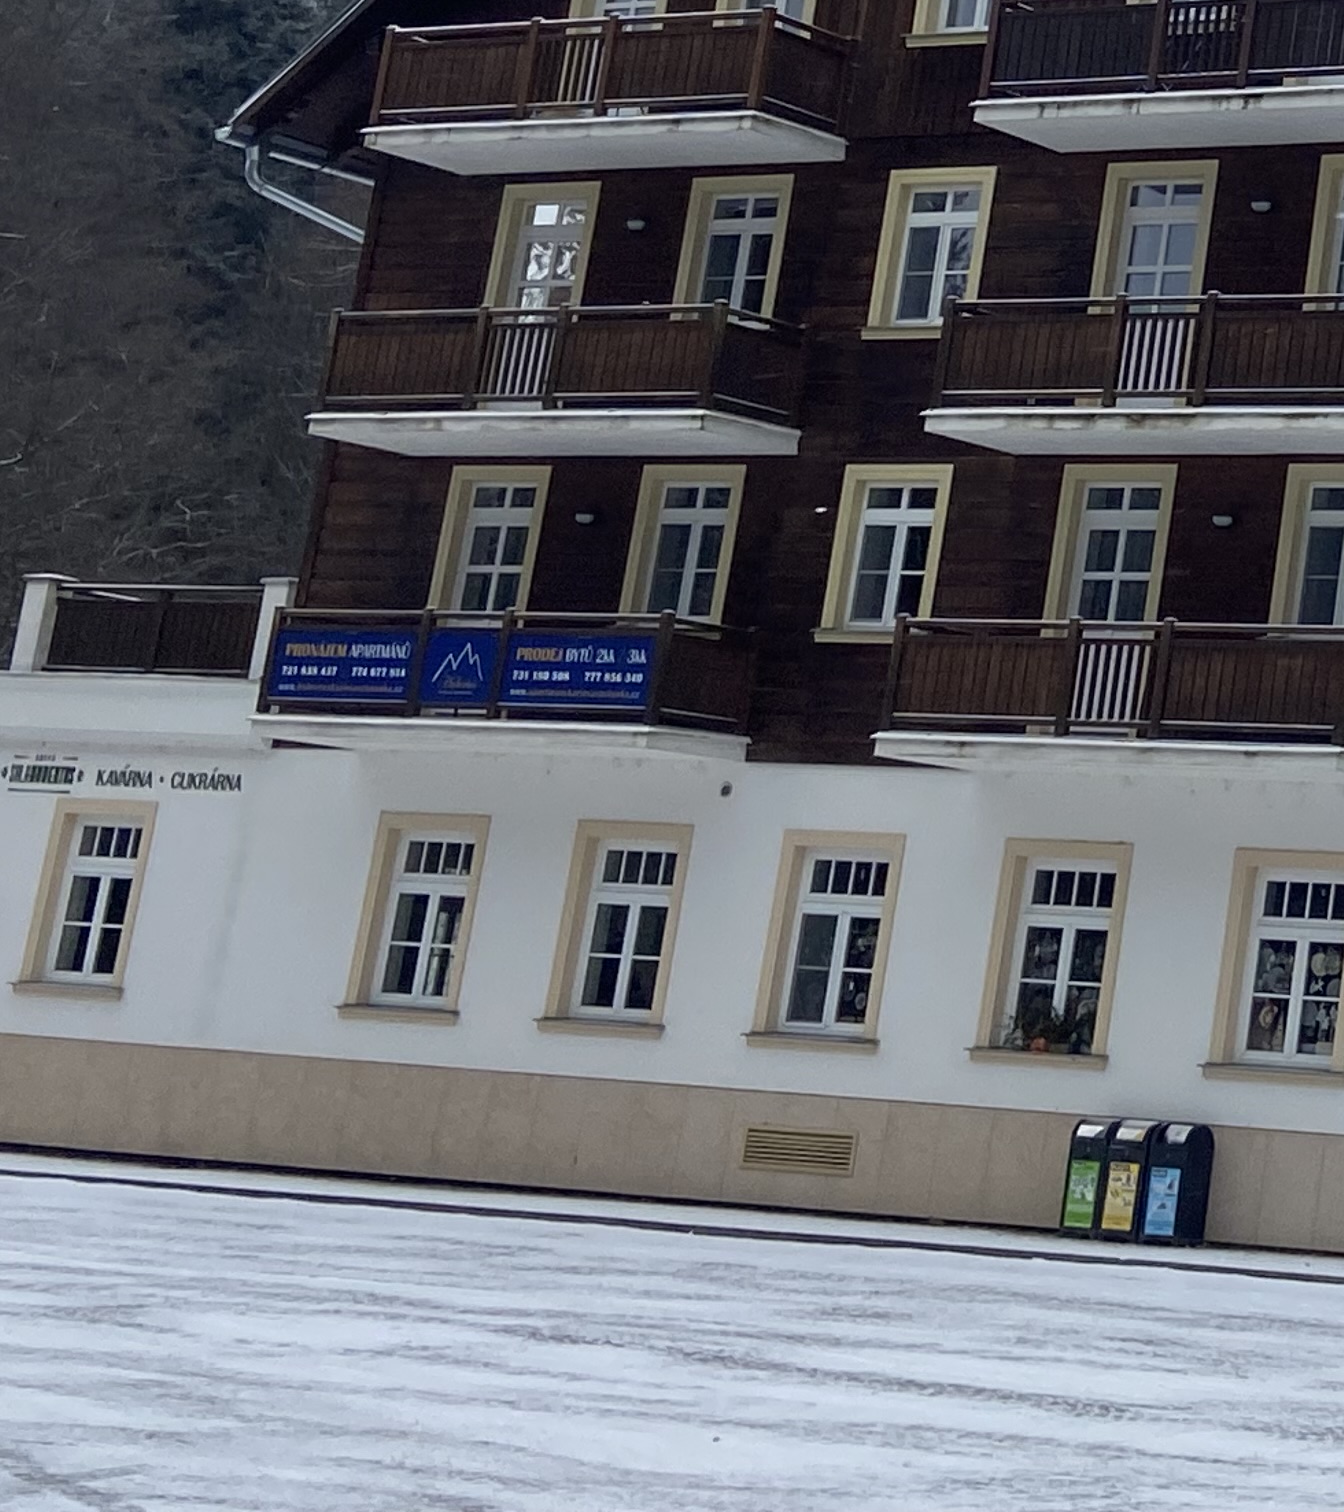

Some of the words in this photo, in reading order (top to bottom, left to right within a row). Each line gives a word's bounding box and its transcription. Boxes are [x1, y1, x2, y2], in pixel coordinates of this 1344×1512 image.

[516, 647, 563, 661] PRODEJ
[565, 645, 592, 663] BYTŮ
[95, 764, 152, 788] KAVÁRNA
[170, 767, 242, 792] CUKRÁRNA
